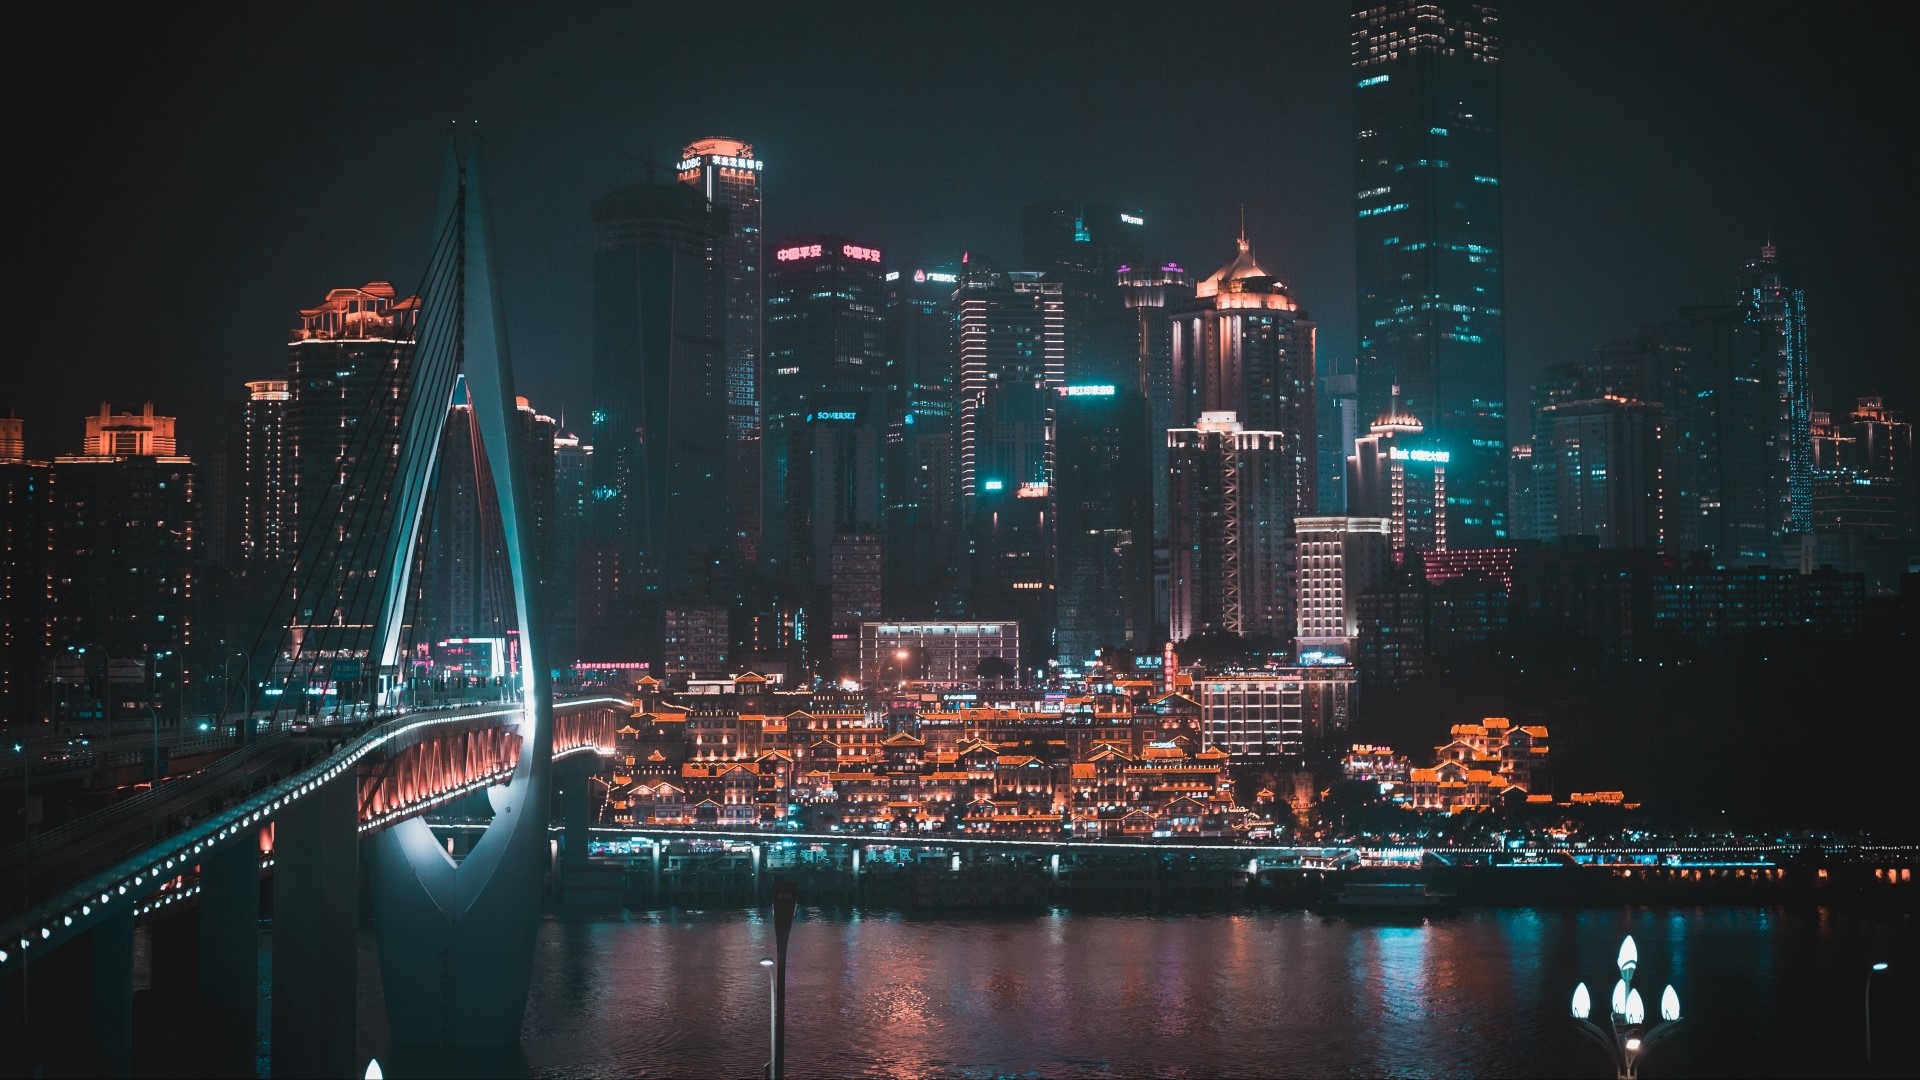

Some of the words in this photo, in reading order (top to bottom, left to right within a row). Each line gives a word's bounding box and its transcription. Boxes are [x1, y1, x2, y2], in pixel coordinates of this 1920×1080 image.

[681, 156, 701, 170] ADBC
[712, 154, 764, 171] 农业发展银行
[777, 244, 821, 261] 中国平安
[843, 244, 881, 262] 中国平安
[817, 411, 857, 420] SOMERSET
[1390, 446, 1410, 460] Bank
[1135, 656, 1162, 666] 洪崖洞
